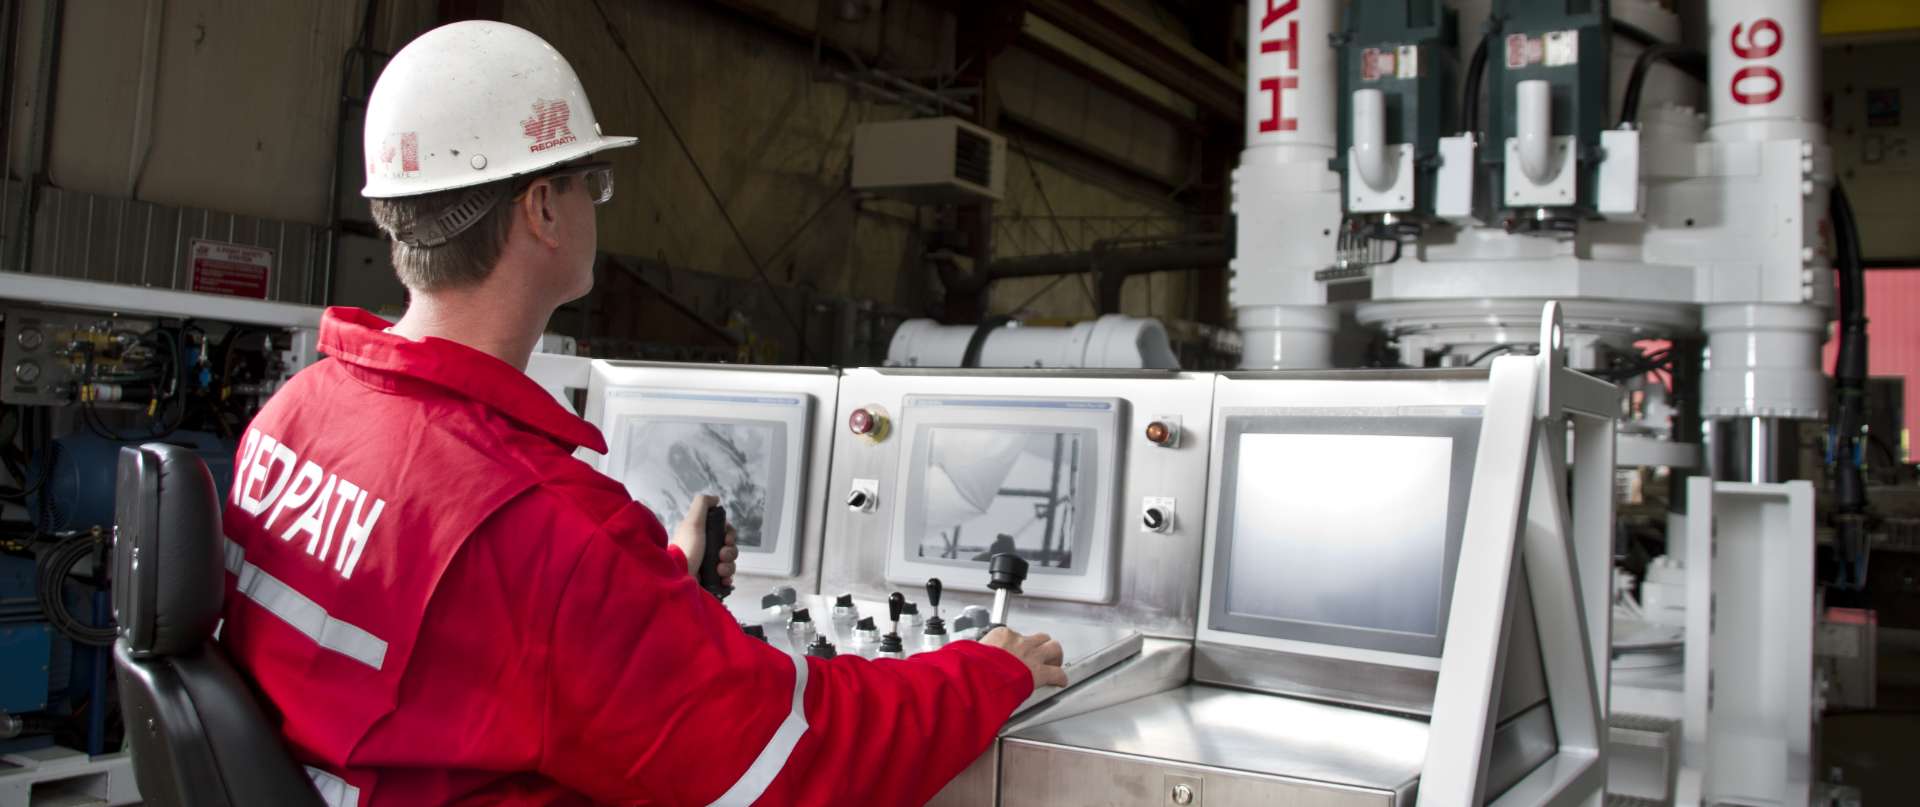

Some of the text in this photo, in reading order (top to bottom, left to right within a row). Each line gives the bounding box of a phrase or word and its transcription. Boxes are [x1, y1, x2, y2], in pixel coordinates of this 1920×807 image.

[1730, 18, 1783, 105] 90
[530, 135, 576, 152] REDPATH
[234, 427, 385, 580] REDPATH
